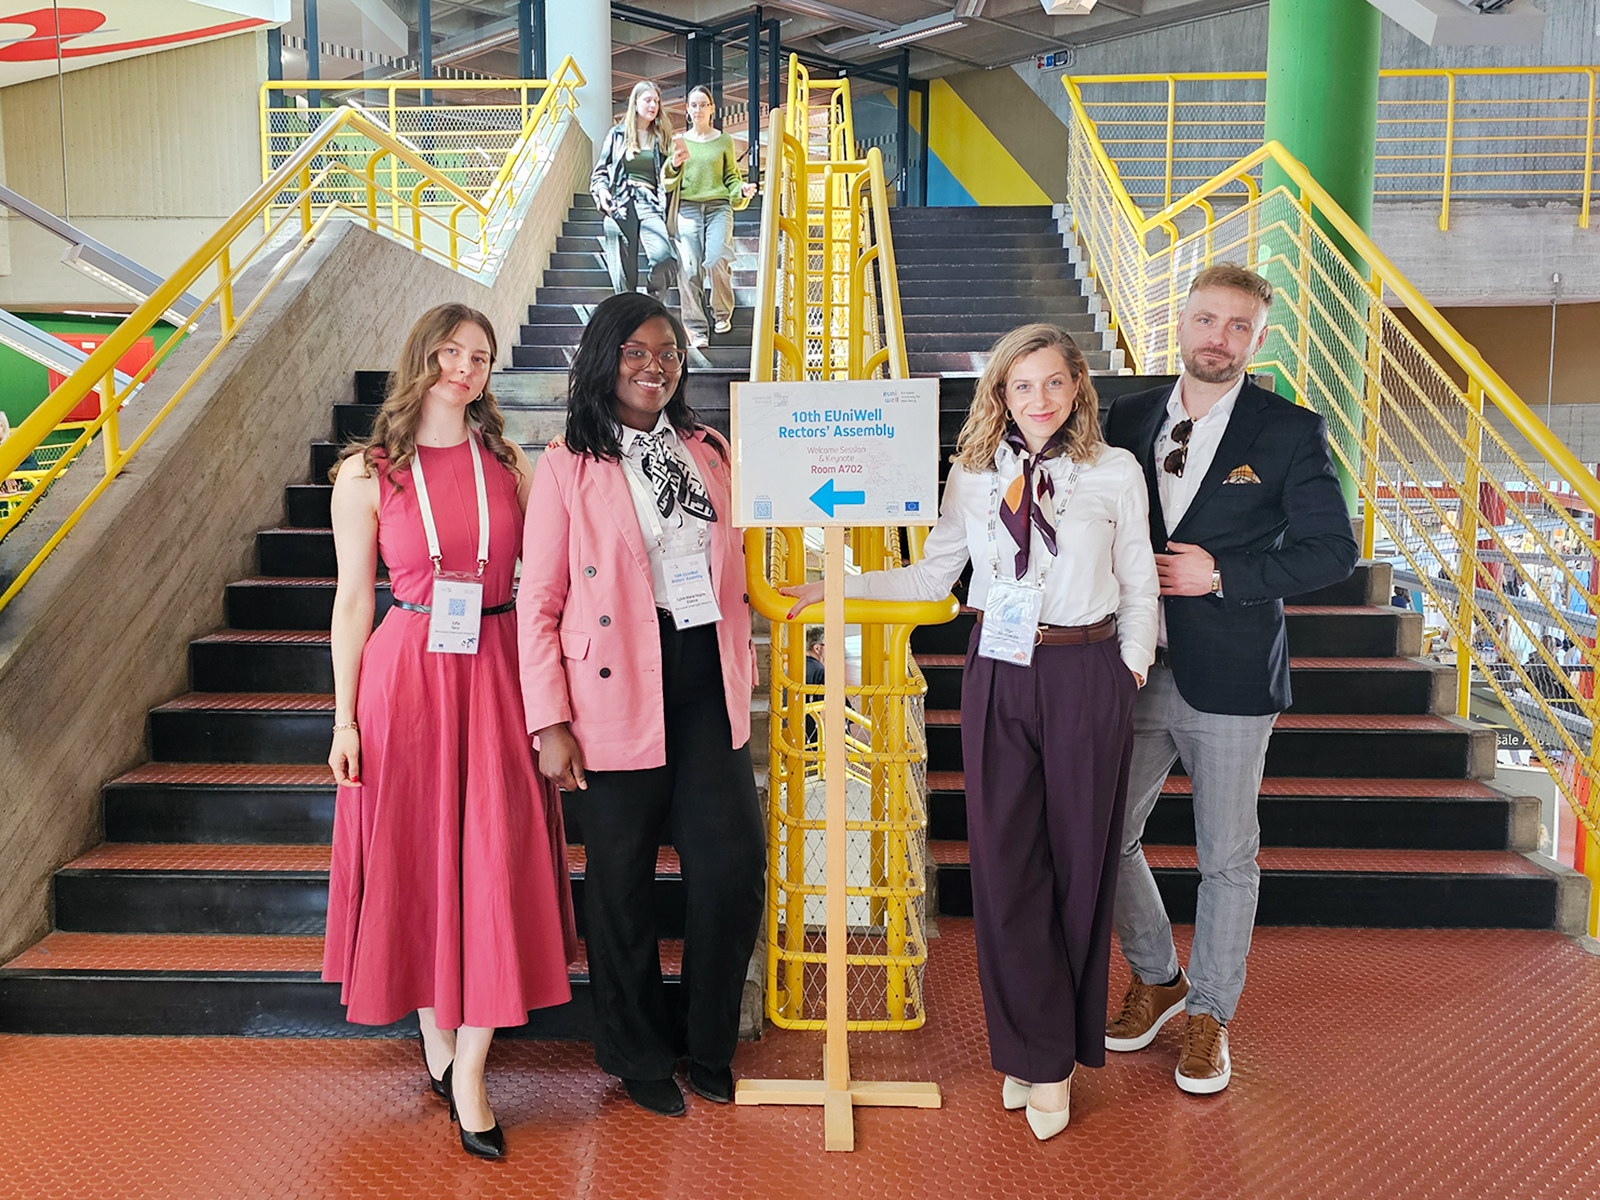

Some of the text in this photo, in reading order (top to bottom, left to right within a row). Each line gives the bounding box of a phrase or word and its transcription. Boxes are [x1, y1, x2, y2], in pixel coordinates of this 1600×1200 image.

[792, 409, 882, 423] 10th EUniWell
[833, 424, 895, 439] Assembly
[807, 446, 866, 454] Welcome Session
[825, 455, 855, 463] Keynote
[811, 465, 863, 474] Room A702
